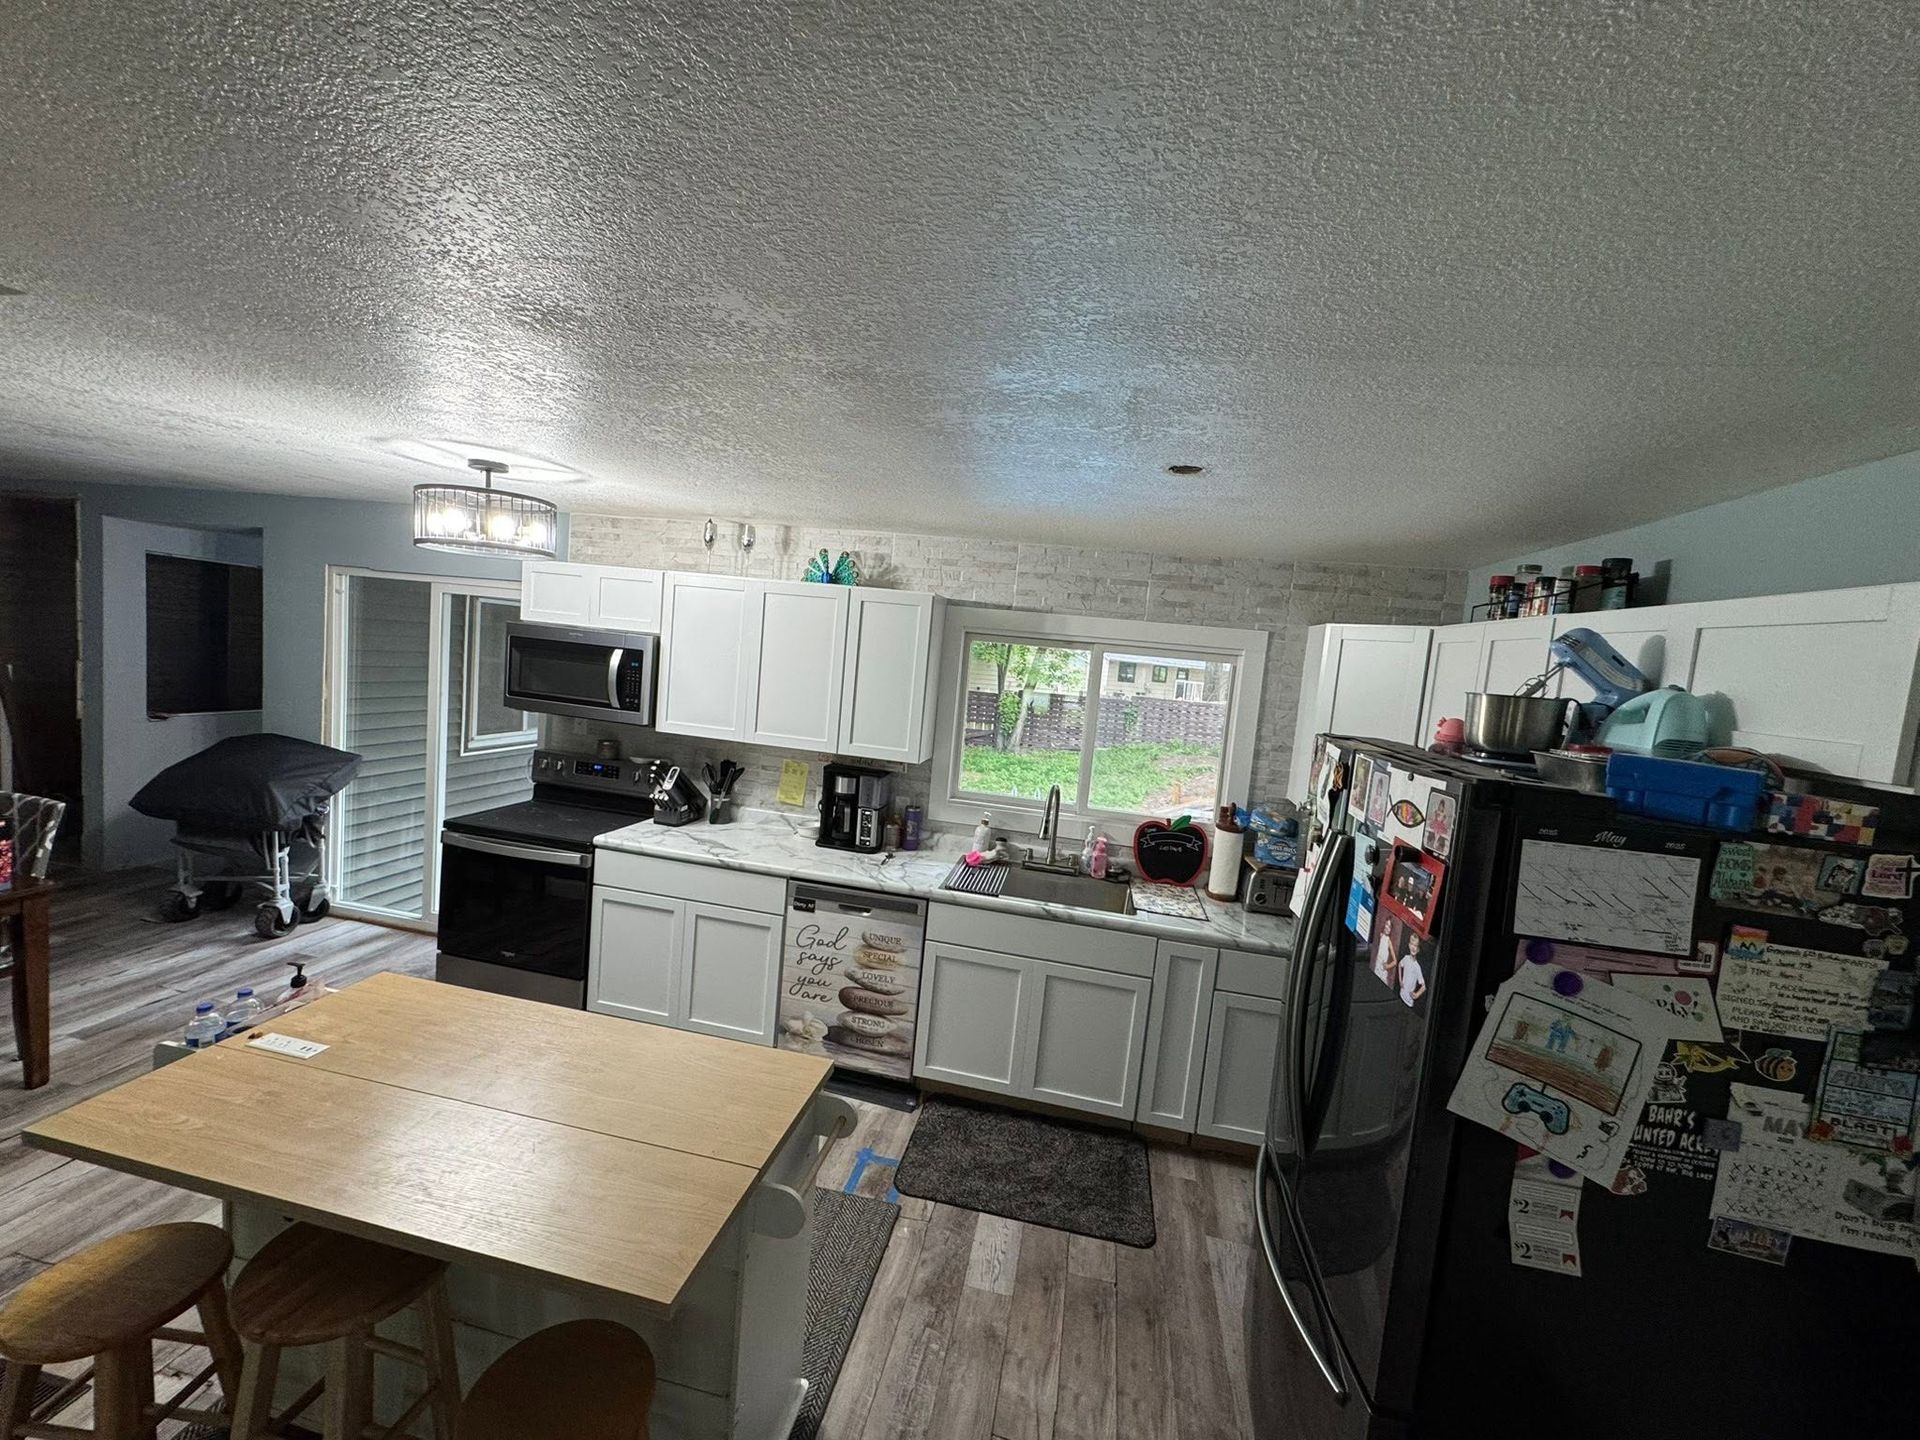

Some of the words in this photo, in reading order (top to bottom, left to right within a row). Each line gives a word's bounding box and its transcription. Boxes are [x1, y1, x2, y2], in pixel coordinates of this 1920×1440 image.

[1592, 830, 1629, 849] May
[796, 924, 849, 950] God
[868, 932, 902, 946] UNIQUE
[797, 952, 843, 975] says
[862, 950, 897, 964] SPECIAL
[862, 970, 896, 984] LOVELY
[789, 976, 832, 996] you
[801, 991, 833, 1003] are
[852, 994, 895, 1009] PRECIOUS
[851, 1016, 886, 1030] STRONG
[1648, 1104, 1697, 1130] BAHR'S
[1633, 1124, 1677, 1148] UNTED
[1513, 1198, 1530, 1214] $2
[1514, 1241, 1532, 1260] $2
